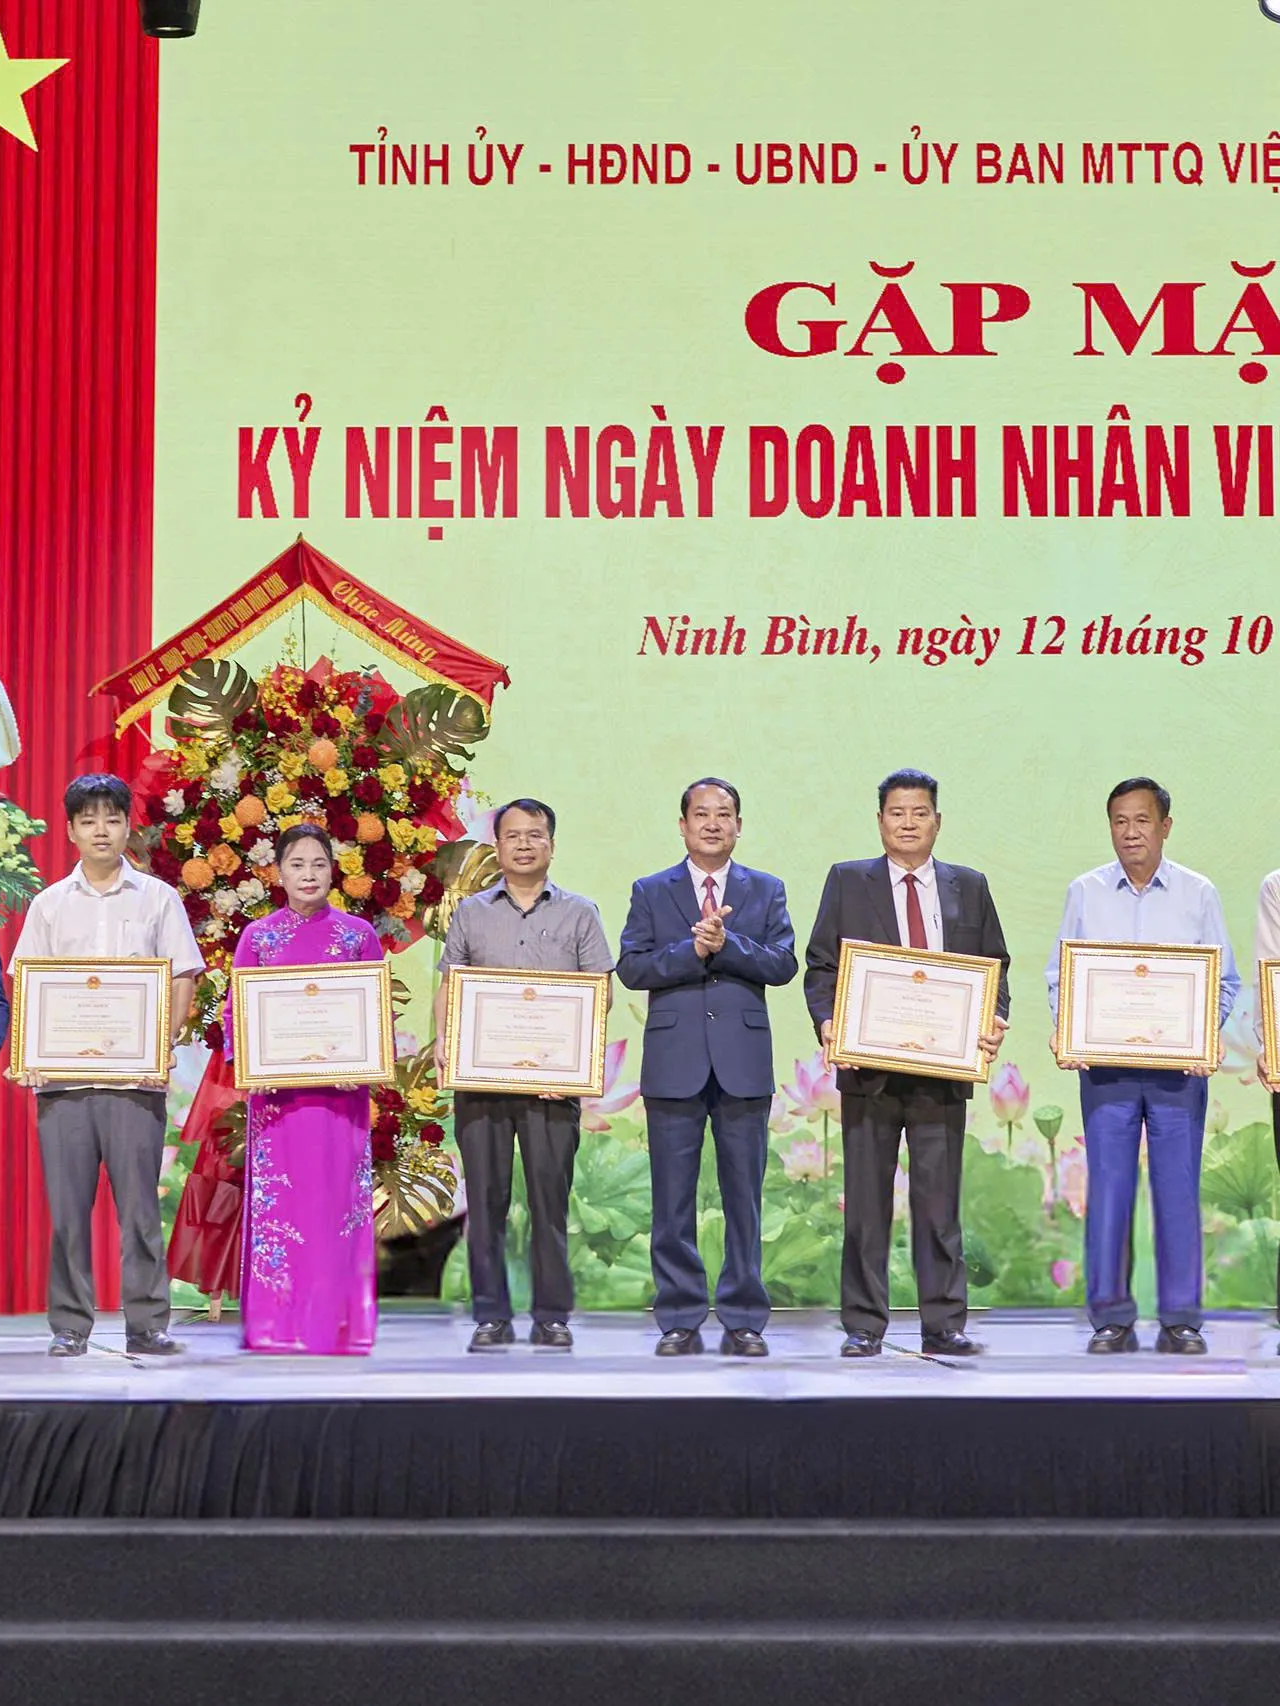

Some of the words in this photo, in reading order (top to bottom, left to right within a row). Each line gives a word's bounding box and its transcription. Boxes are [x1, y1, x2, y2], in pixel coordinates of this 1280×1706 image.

[350, 127, 448, 185] TỈNH
[468, 127, 522, 185] ỦY
[568, 143, 691, 185] HĐND
[736, 143, 858, 185] UBND
[903, 126, 957, 185] ỦY
[977, 143, 1063, 185] BAN
[1083, 142, 1202, 186] MTTQ
[1219, 131, 1280, 193] VIỆ
[745, 261, 1030, 384] GẶP
[1074, 261, 1280, 384] MẶ
[237, 393, 320, 519] KỶ
[345, 405, 518, 540] NIỆM
[546, 405, 724, 518] NGÀY
[749, 424, 976, 518] DOANH
[1003, 404, 1190, 517] NHÂN
[331, 580, 380, 622] Chúc
[378, 617, 439, 664] Mừng
[639, 615, 746, 656] Ninh
[762, 615, 881, 663] Bình,
[898, 615, 1001, 666] ngày
[1019, 615, 1066, 655] 12
[1081, 614, 1207, 665] tháng
[1222, 615, 1273, 655] 10
